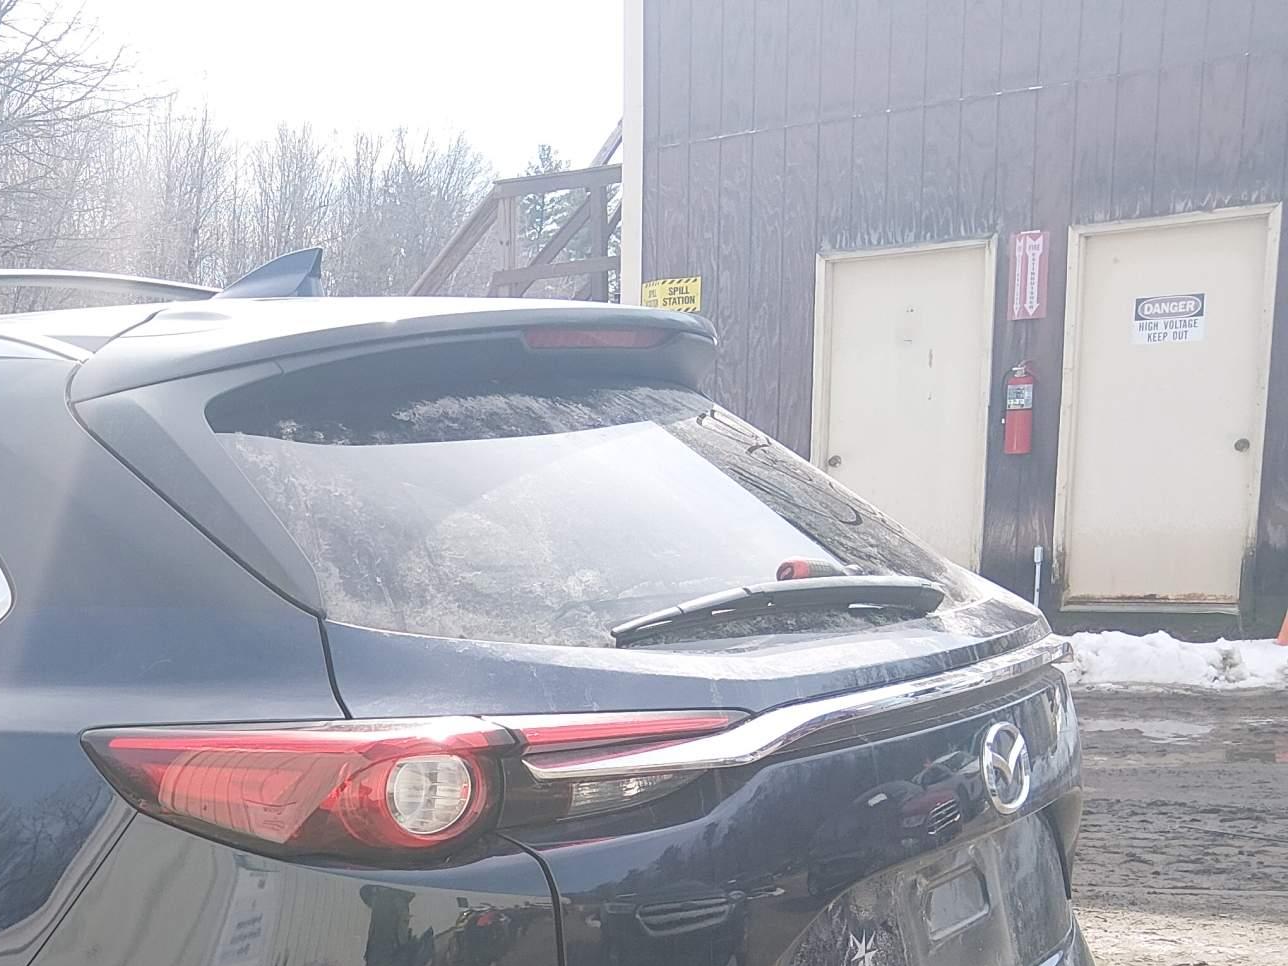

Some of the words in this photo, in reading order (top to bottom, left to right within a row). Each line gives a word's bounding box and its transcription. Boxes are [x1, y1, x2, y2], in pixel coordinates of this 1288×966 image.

[668, 286, 690, 296] SPILL
[662, 295, 696, 307] STATION
[1143, 300, 1196, 315] DANGER
[1138, 321, 1159, 332] HIGH
[1163, 319, 1200, 330] VOLTAGE
[1147, 331, 1168, 342] KEEP
[1172, 330, 1189, 340] OUT
